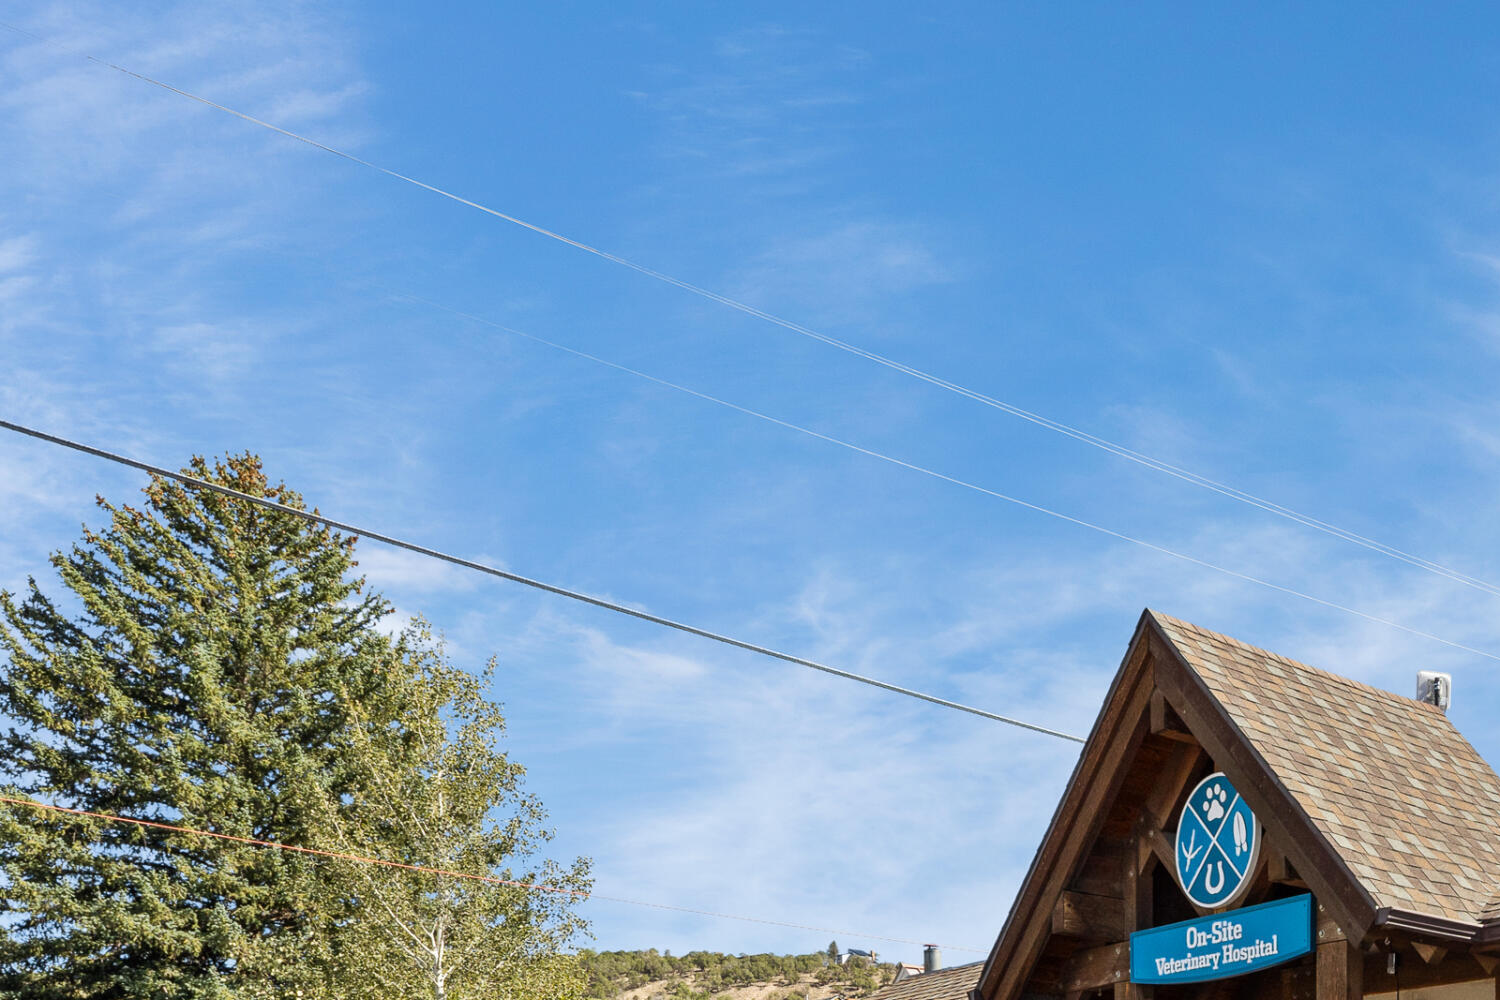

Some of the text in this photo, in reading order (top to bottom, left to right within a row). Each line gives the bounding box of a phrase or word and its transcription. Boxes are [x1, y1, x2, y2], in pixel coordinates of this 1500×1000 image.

[1186, 920, 1242, 949] On-Site
[1155, 934, 1278, 976] Veterinary Hospital
